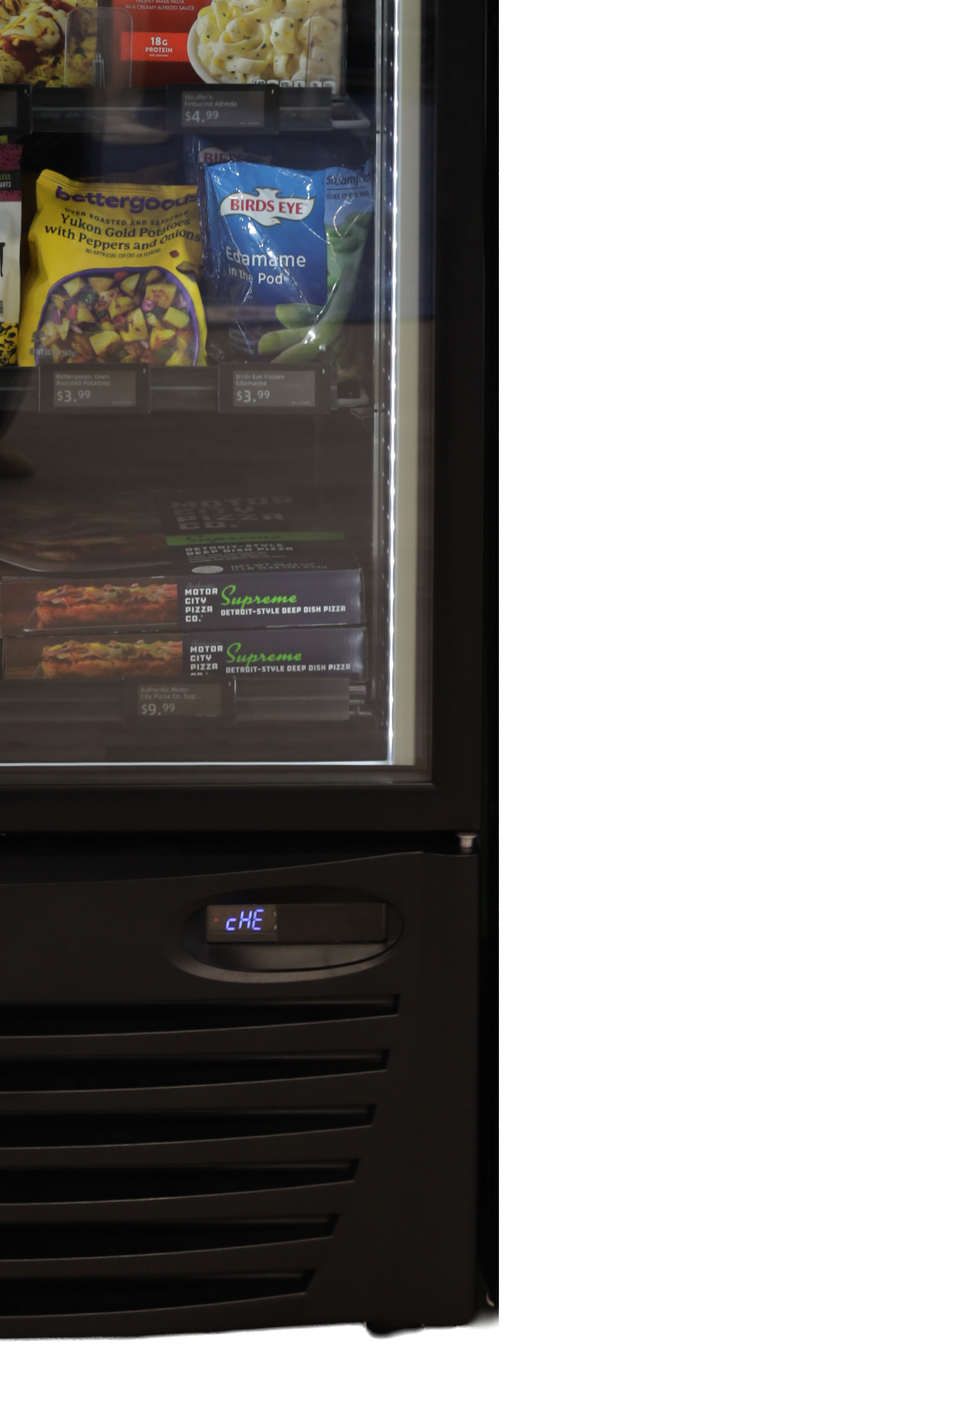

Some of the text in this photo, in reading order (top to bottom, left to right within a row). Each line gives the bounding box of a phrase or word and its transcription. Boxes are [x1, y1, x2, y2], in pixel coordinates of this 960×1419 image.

[150, 36, 168, 46] 18G
[185, 110, 219, 123] $4.99
[230, 198, 304, 215] BIRDS EYE
[44, 225, 202, 251] with Peppers and Onions
[225, 246, 306, 268] Edamame
[57, 390, 91, 403] $3.99
[236, 389, 271, 403] $3.99
[178, 521, 239, 530] CO.
[184, 587, 218, 596] MOTOR
[220, 584, 298, 609] Supreme
[184, 597, 207, 605] CITY
[185, 605, 213, 614] PIZZA
[220, 605, 346, 616] DETROIT-STYLE DEEP DISH PIZZA
[185, 614, 202, 623] CO.
[189, 645, 224, 653] MOTOR
[225, 642, 303, 667] Supreme
[189, 654, 212, 662] CITY
[190, 663, 219, 671] PIZZA
[225, 664, 285, 674] DETROIT-STYLE
[286, 664, 307, 672] DEEP
[308, 663, 327, 671] DISH
[141, 702, 176, 716] $9.99
